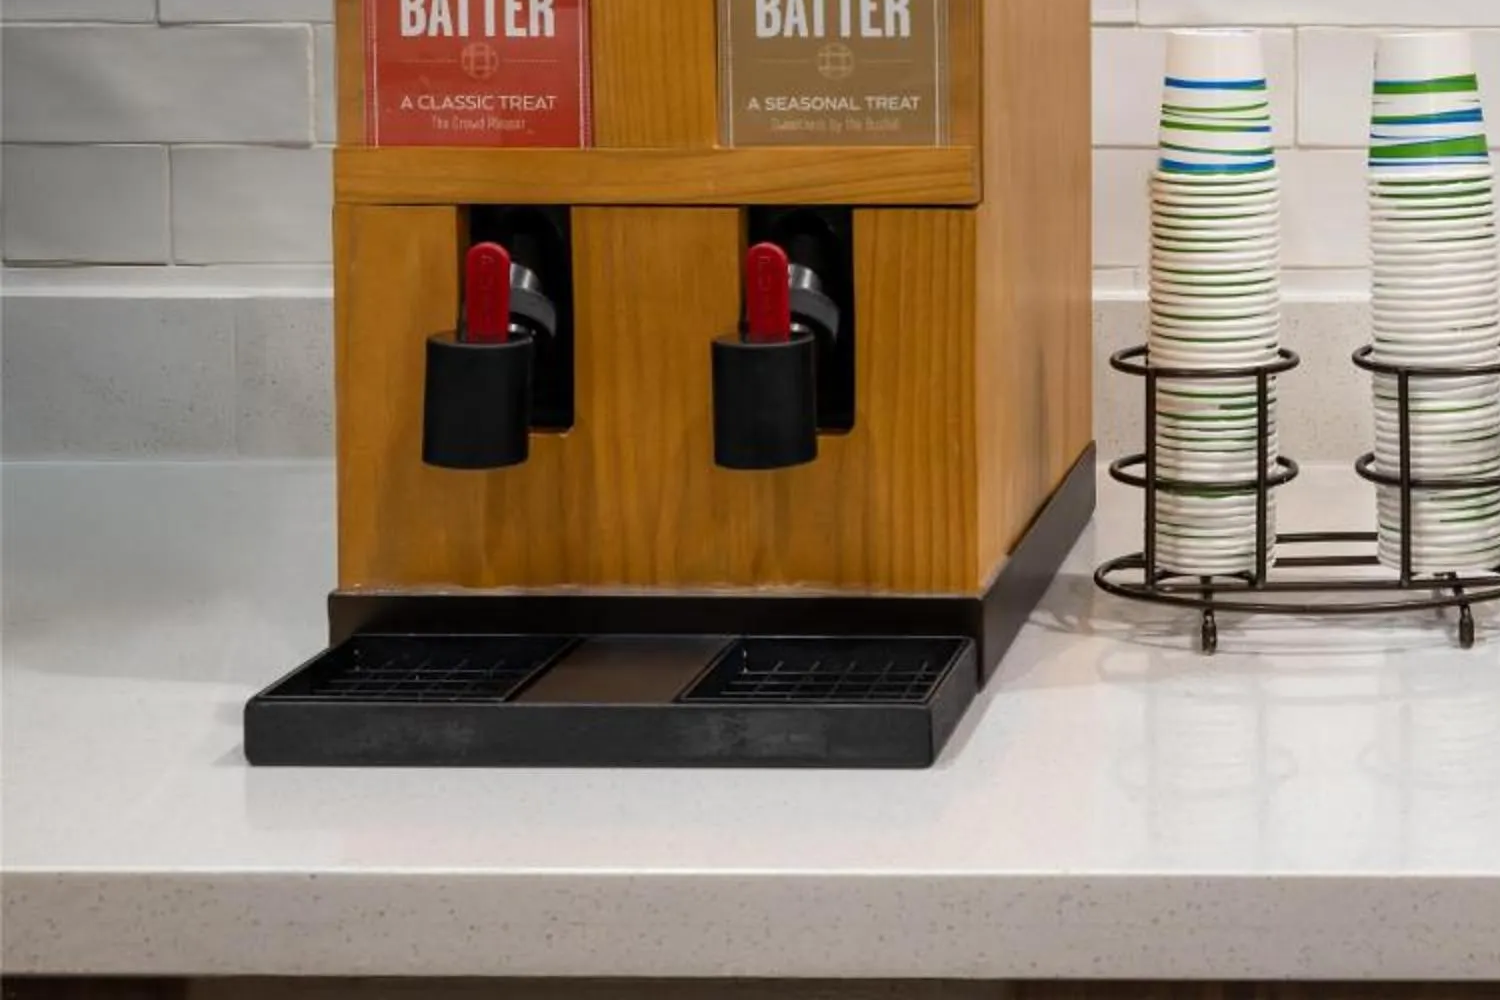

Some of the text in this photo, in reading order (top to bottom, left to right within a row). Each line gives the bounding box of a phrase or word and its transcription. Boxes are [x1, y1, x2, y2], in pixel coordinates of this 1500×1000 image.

[400, 95, 557, 110] A CLASSIC TREAT
[748, 95, 920, 111] A SEASONAL TREAT
